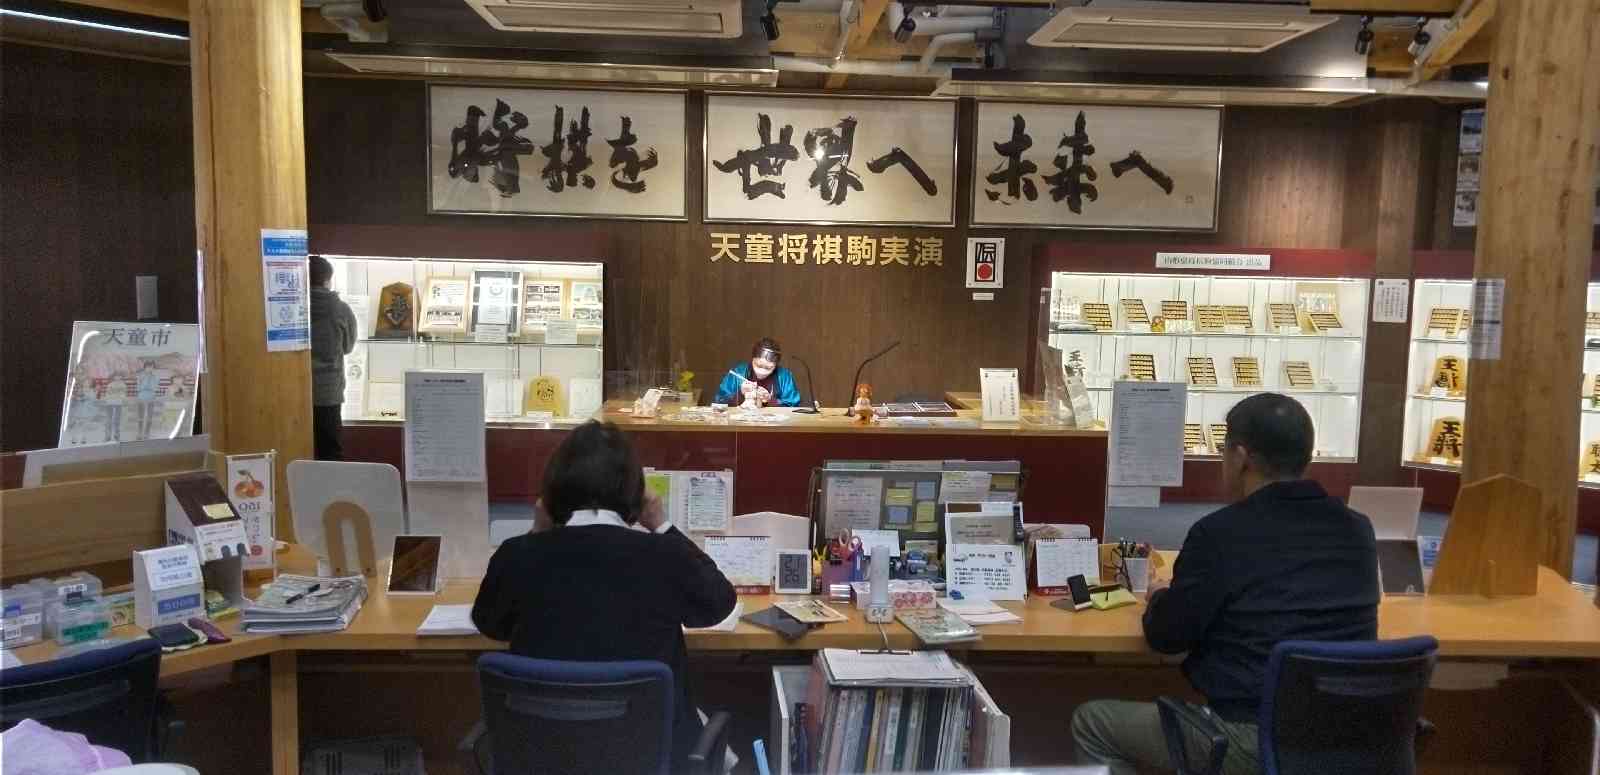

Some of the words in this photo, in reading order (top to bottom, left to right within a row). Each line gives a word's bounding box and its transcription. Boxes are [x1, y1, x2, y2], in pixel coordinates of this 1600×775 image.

[448, 98, 659, 197] 将棋を
[712, 112, 938, 206] 世界へ
[985, 109, 1174, 213] 未来へ
[709, 231, 944, 268] 天童将棋駒実演
[102, 328, 172, 347] 天童市
